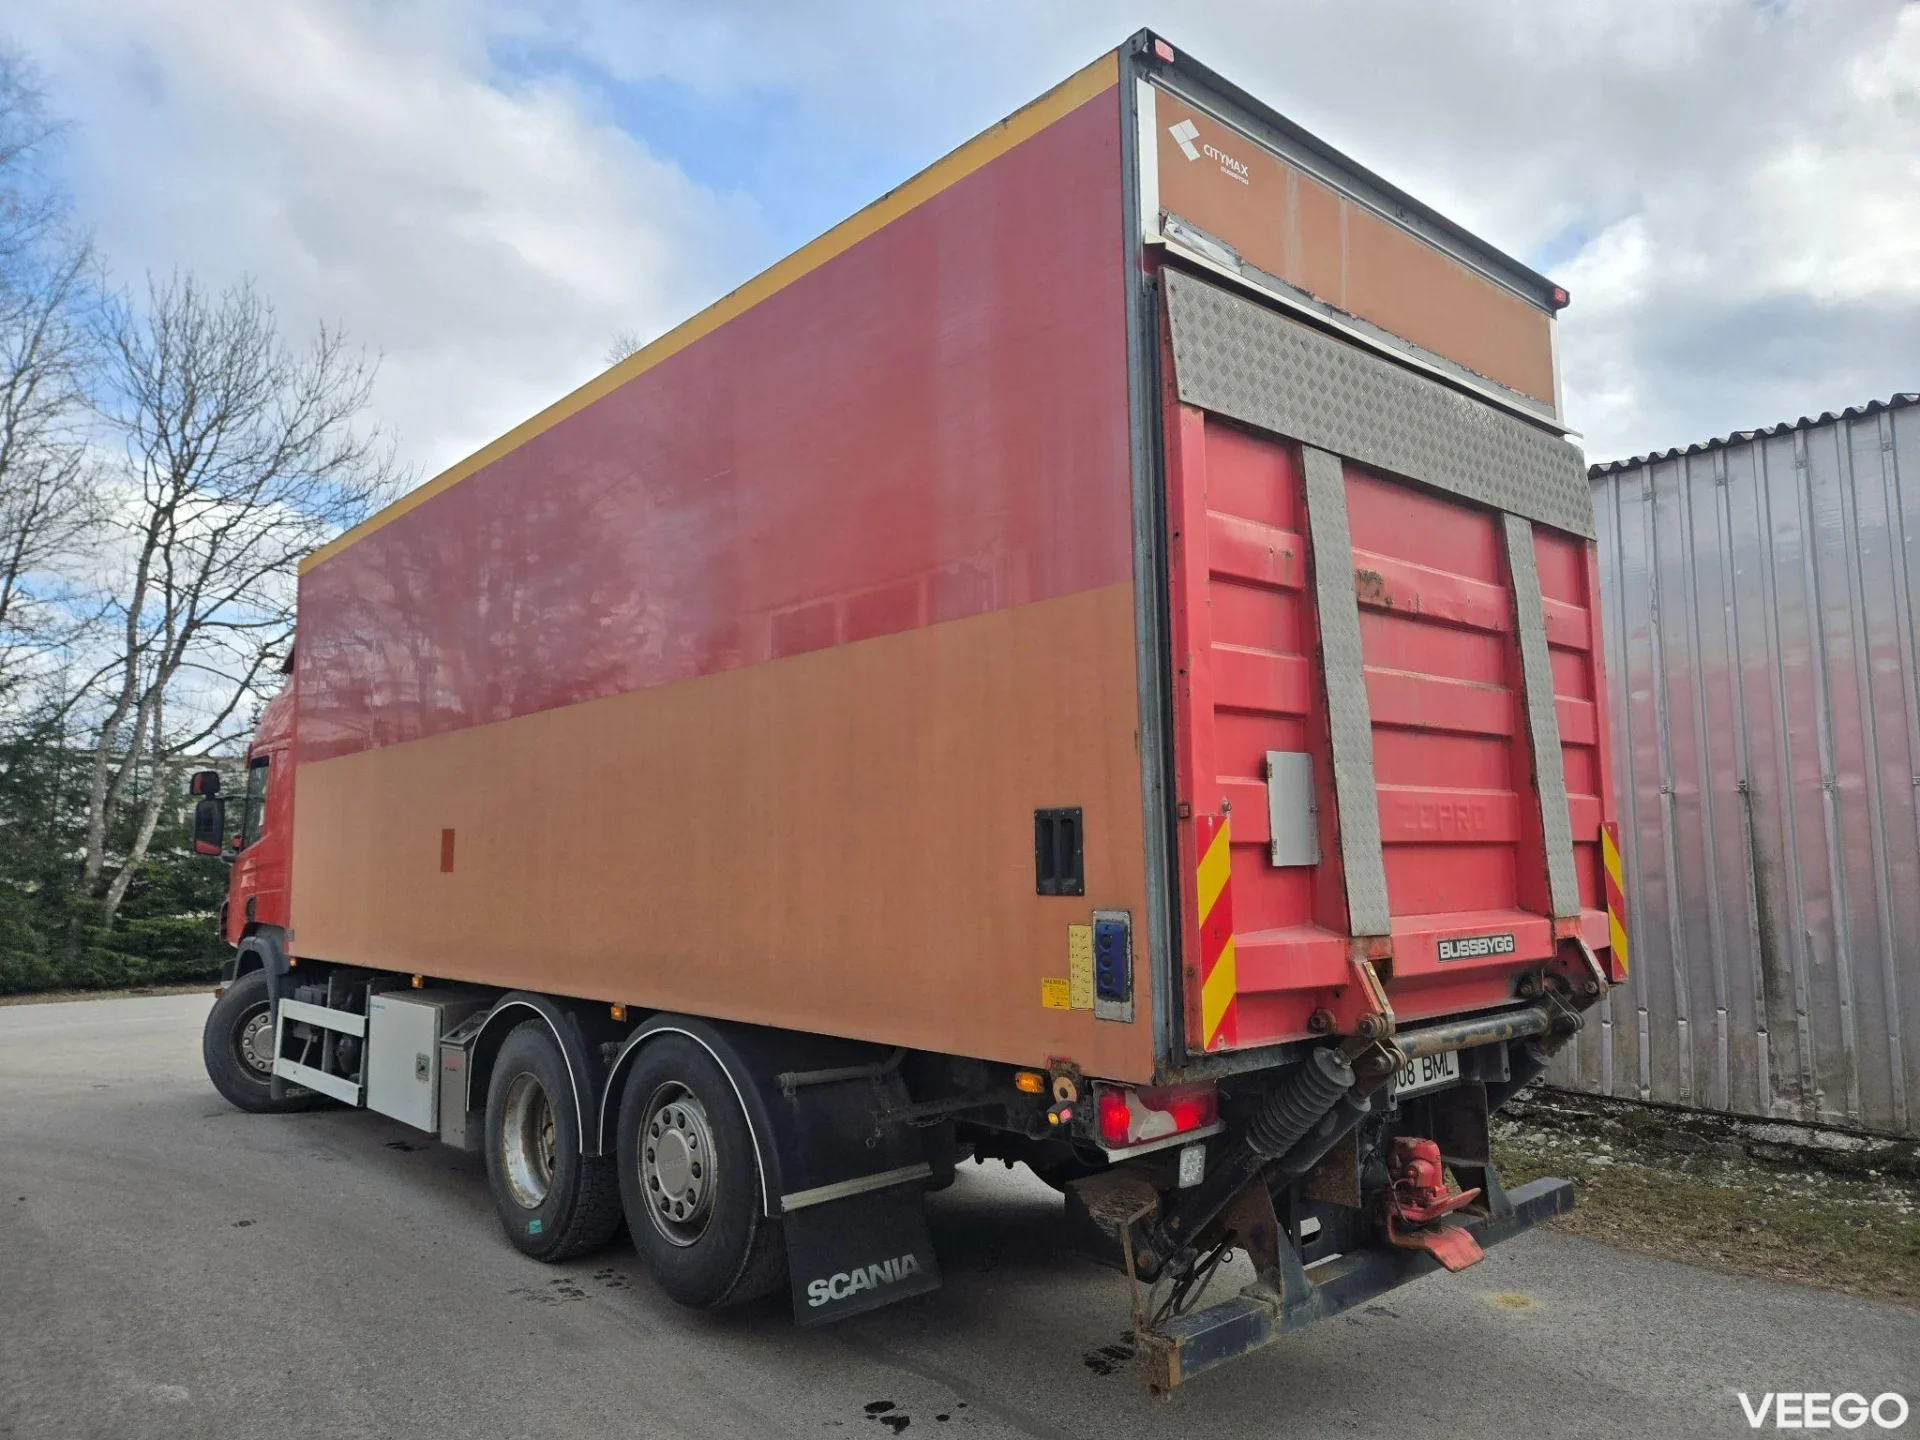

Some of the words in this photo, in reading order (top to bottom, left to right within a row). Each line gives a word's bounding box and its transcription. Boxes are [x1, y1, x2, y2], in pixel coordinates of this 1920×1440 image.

[1203, 144, 1249, 177] CITYMAX
[1440, 936, 1514, 959] BUSSBYGG
[1394, 1060, 1416, 1088] 08
[1422, 1052, 1454, 1081] BML
[807, 1254, 921, 1307] SCANIA
